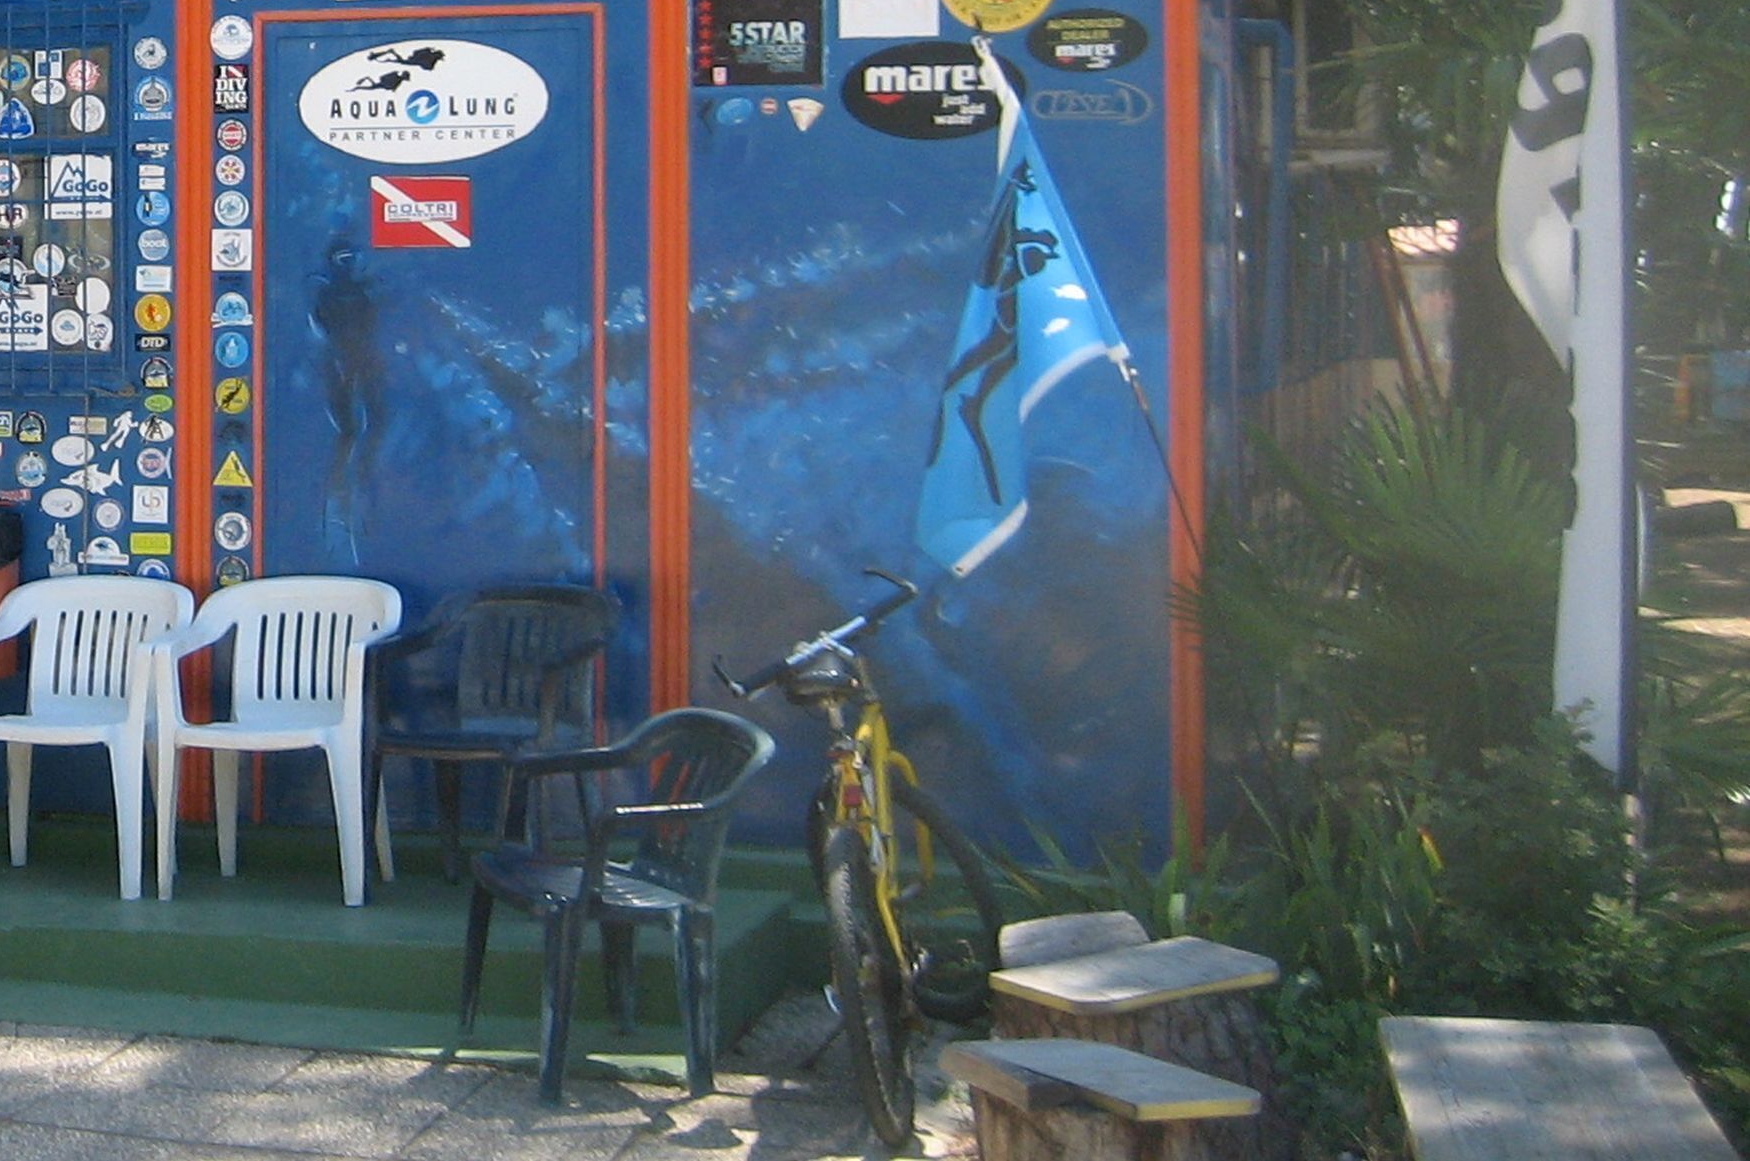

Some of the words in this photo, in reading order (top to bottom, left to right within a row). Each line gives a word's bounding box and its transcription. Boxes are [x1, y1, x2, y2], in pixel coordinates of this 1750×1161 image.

[730, 21, 744, 46] 5
[745, 20, 806, 45] STAR
[1055, 43, 1117, 57] mares
[215, 78, 247, 91] DIV
[215, 91, 248, 104] ING
[329, 99, 397, 119] AQUA
[449, 96, 516, 116] LUNG
[329, 130, 420, 142] PARTNER
[435, 129, 516, 141] CENTER
[388, 203, 454, 214] COLTRI
